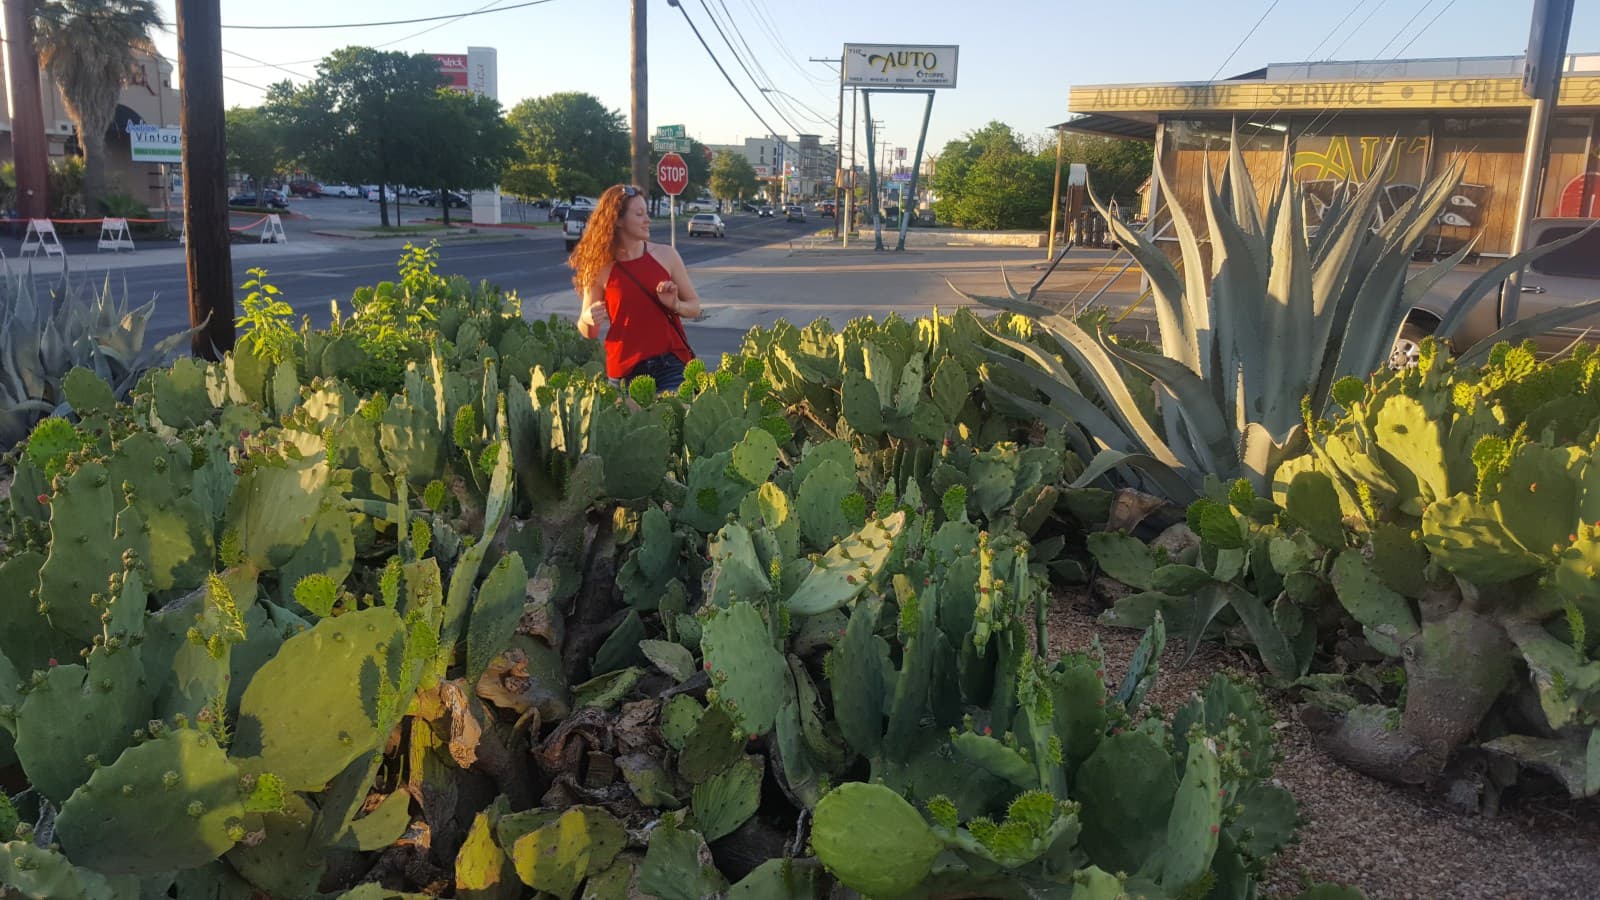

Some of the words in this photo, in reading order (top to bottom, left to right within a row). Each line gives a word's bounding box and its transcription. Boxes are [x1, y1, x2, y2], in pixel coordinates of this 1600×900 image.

[868, 51, 937, 73] AUTO
[1092, 85, 1240, 109] AUTOMOTIVE
[1270, 80, 1385, 106] SERVICE
[136, 132, 182, 144] Vintag
[657, 127, 674, 137] North
[660, 166, 686, 182] STOP
